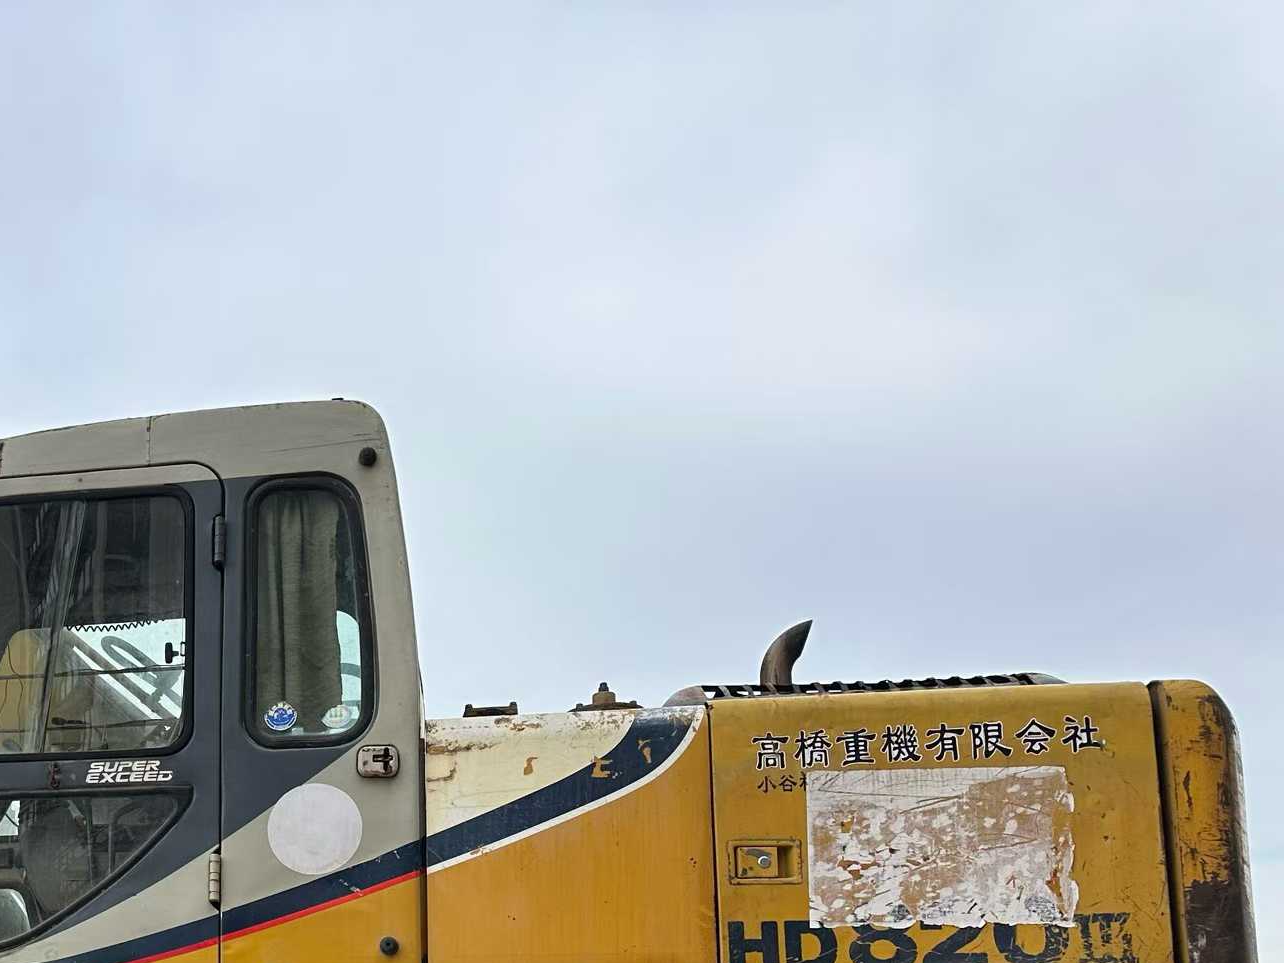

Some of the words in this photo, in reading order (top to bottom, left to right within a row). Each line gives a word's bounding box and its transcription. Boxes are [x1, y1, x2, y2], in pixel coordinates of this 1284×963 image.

[750, 714, 1102, 770] 高橋重機有限会社
[87, 760, 161, 773] SUPER
[85, 770, 173, 784] EXCEED
